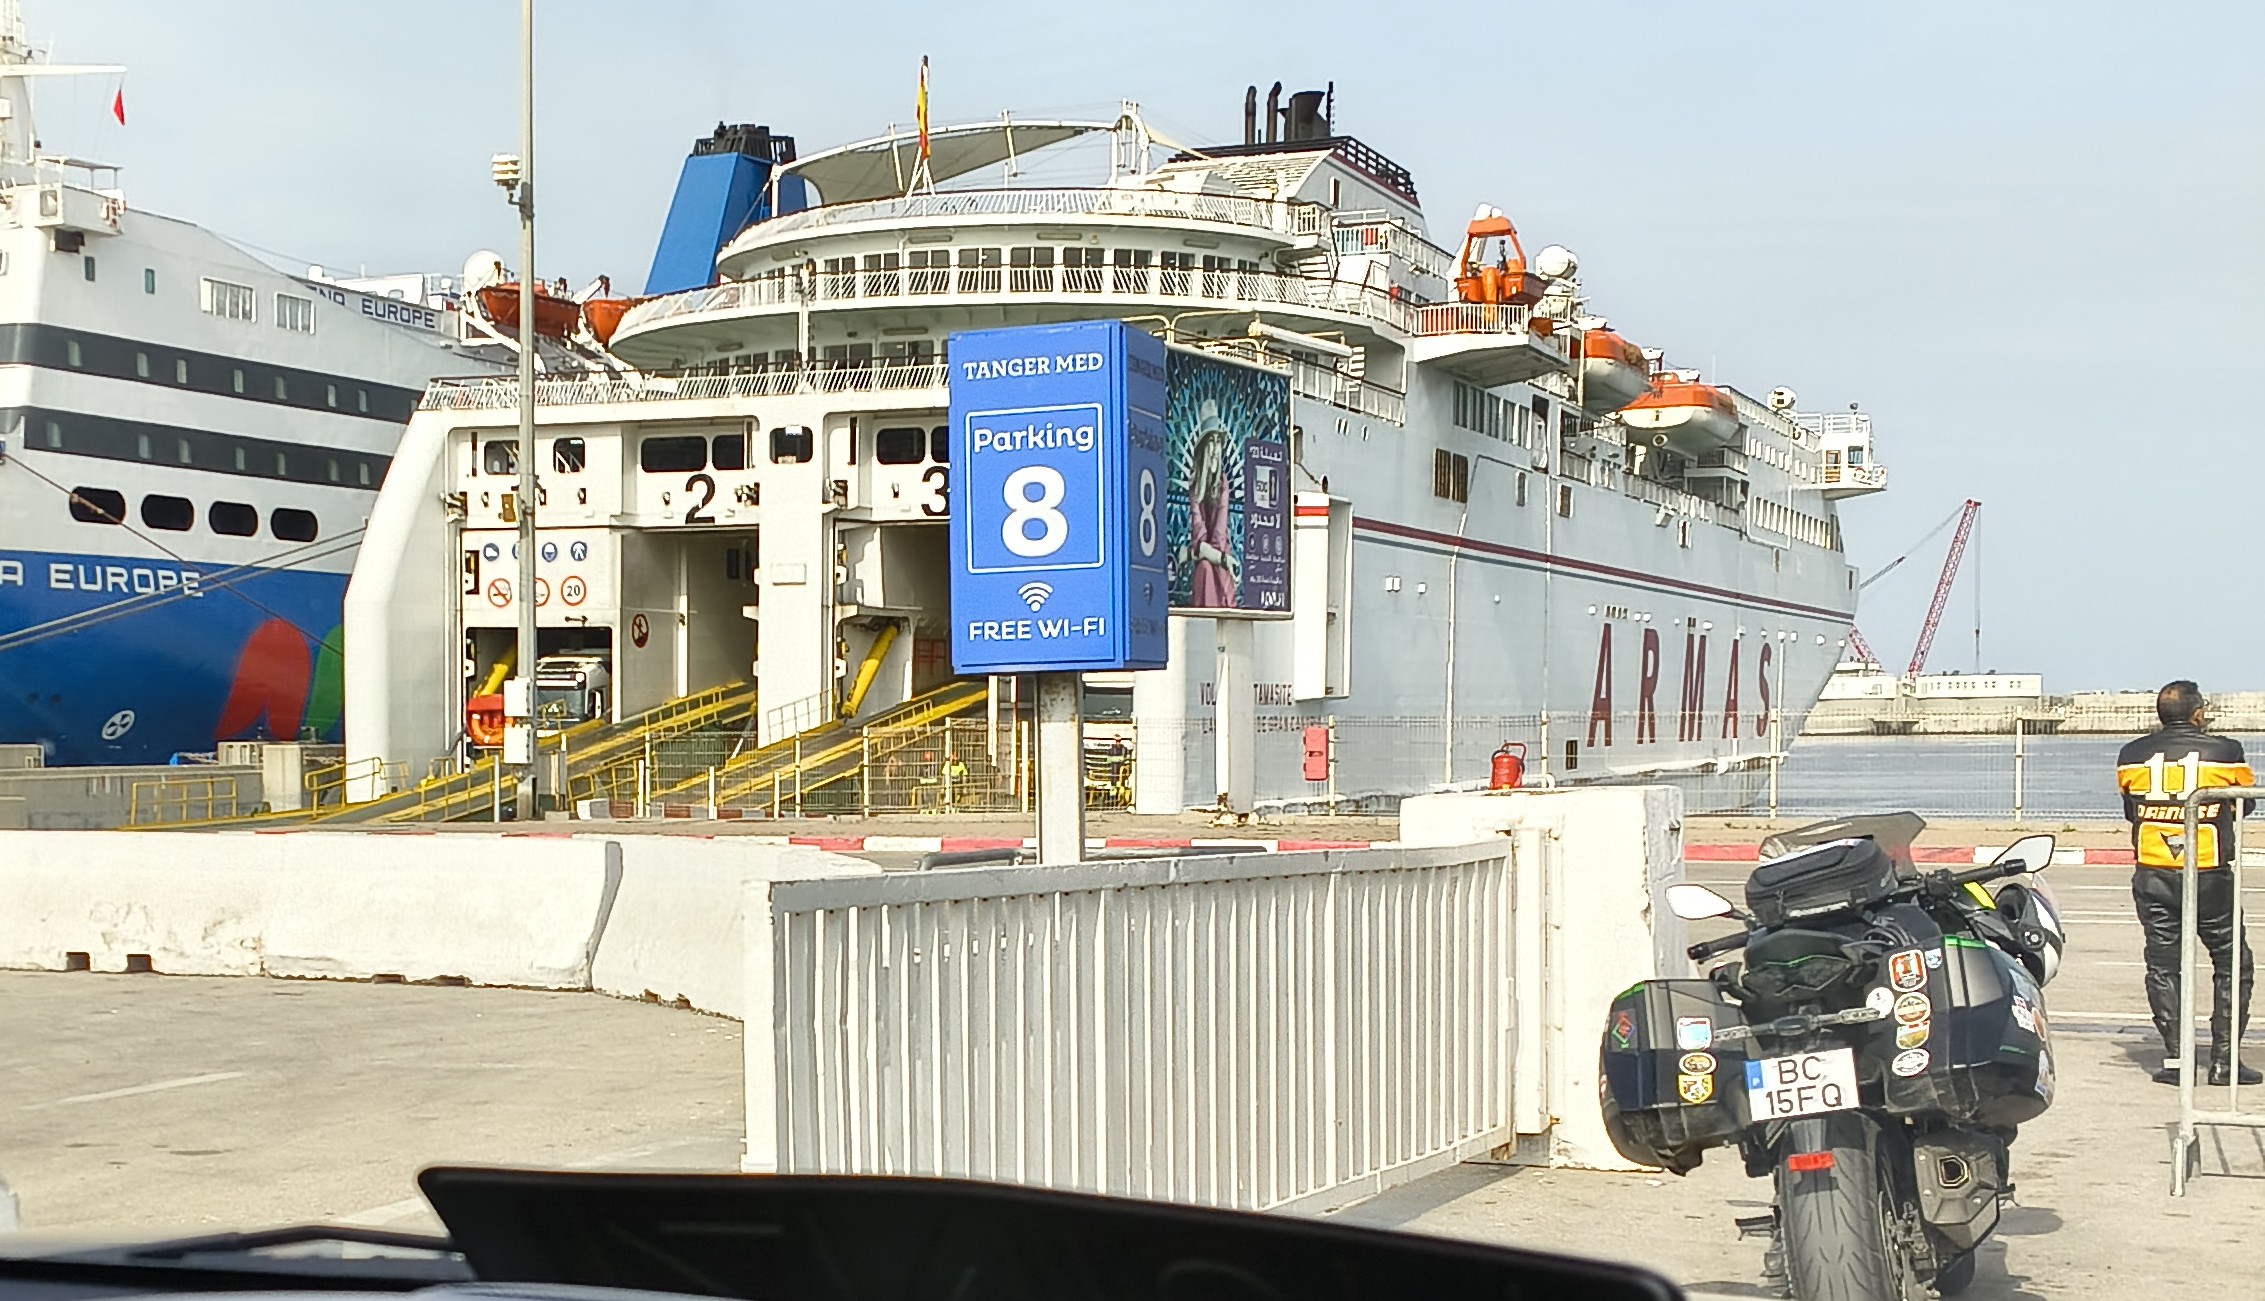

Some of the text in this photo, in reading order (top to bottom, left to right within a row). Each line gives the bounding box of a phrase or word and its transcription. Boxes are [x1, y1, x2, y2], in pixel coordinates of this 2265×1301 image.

[361, 298, 436, 329] EUROPE
[962, 356, 1051, 381] TANGER
[1054, 352, 1104, 374] MED
[973, 422, 1094, 453] Parking
[685, 473, 716, 524] 2
[1001, 465, 1069, 559] 8
[1139, 468, 1156, 557] 8
[50, 562, 204, 597] EUROPE
[566, 584, 581, 597] 20
[968, 620, 1033, 642] FREE
[1037, 617, 1106, 639] WI-FI
[1587, 622, 1772, 748] ARMAS
[2144, 751, 2200, 801] 11
[1777, 1055, 1821, 1085] BC
[1765, 1083, 1843, 1116] 15FQ
